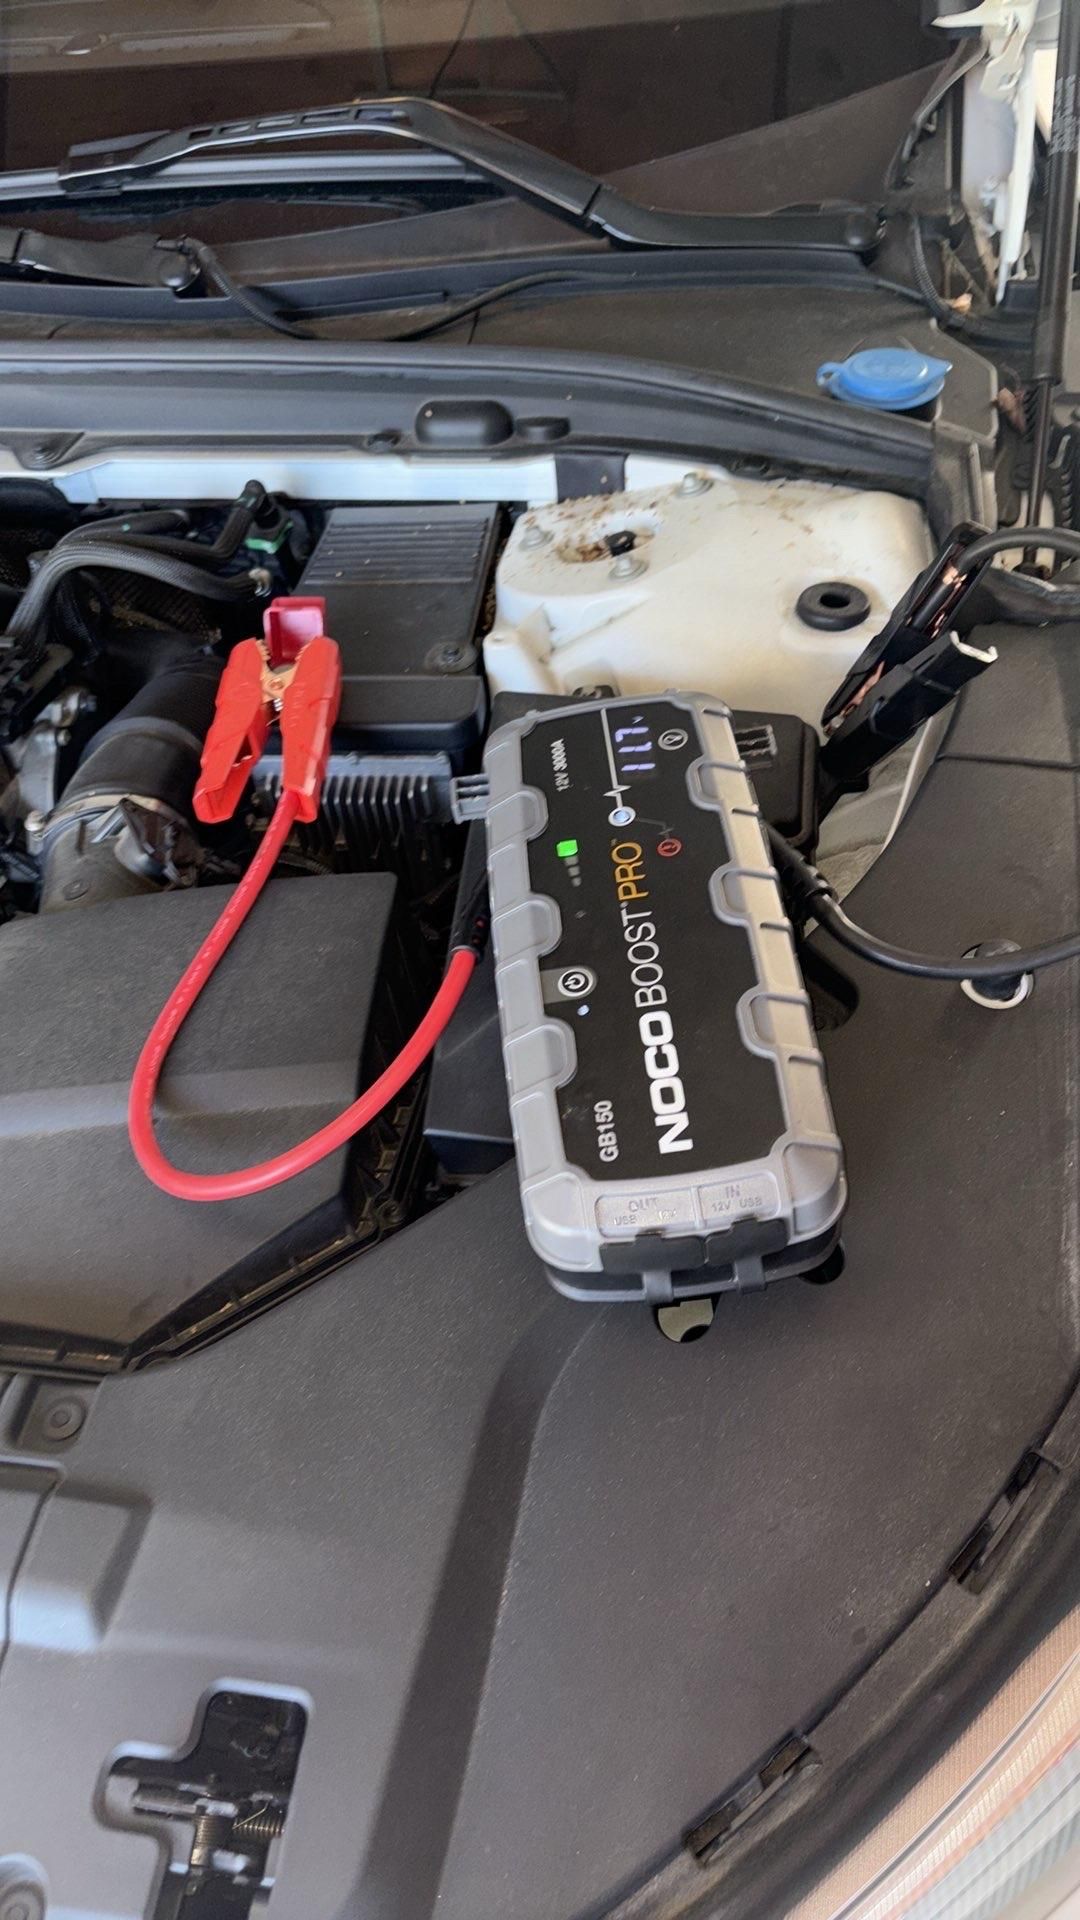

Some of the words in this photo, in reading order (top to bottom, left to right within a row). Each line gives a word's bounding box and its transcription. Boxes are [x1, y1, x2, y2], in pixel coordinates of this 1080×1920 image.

[550, 738, 568, 771] 3000A
[554, 772, 570, 792] 12V
[611, 842, 650, 901] PRO
[620, 908, 668, 1008] BOOST
[638, 1010, 694, 1155] NOCO
[593, 1100, 619, 1162] GB150
[628, 1197, 657, 1212] OUT
[711, 1199, 731, 1212] 12V
[739, 1197, 762, 1209] USB
[725, 1184, 740, 1199] IN
[613, 1214, 636, 1226] USB
